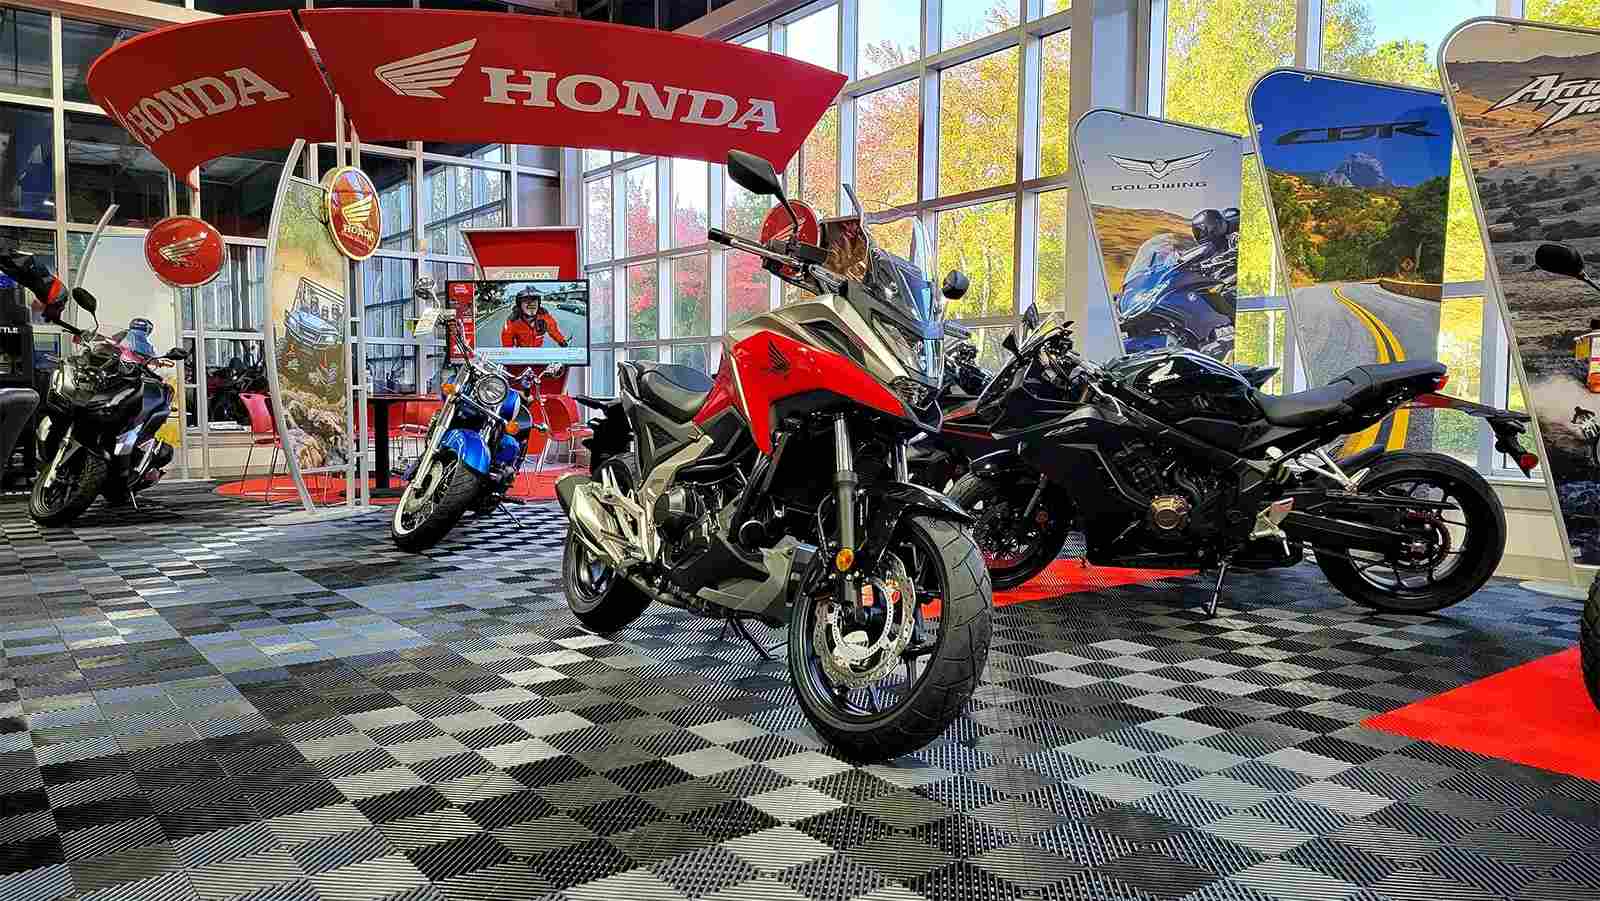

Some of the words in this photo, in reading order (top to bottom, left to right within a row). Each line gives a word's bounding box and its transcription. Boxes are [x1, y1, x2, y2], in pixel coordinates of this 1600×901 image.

[126, 66, 290, 143] HONDA
[480, 66, 781, 133] HONDA
[1273, 120, 1441, 146] CBR
